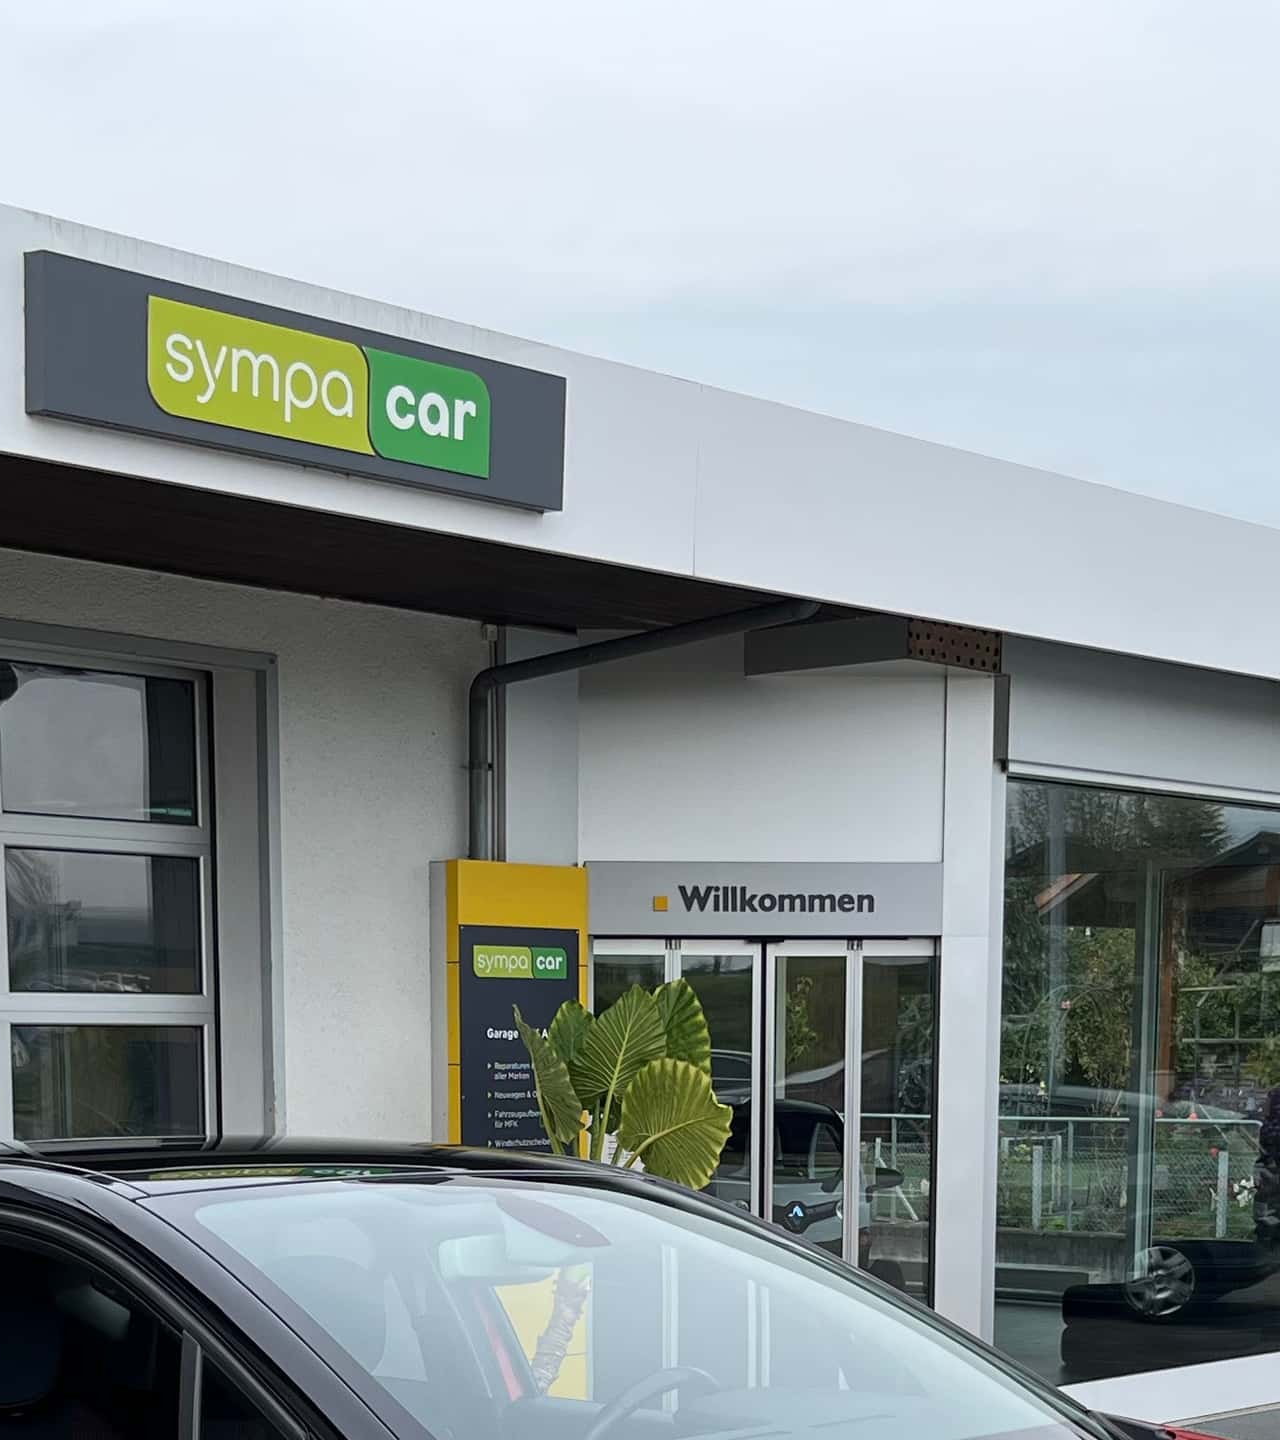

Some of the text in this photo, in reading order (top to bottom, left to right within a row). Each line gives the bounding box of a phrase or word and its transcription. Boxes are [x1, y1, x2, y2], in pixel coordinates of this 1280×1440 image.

[165, 333, 477, 441] sympa car
[677, 884, 875, 913] Willkommen
[477, 953, 563, 973] sympa car
[486, 1027, 520, 1041] Garage
